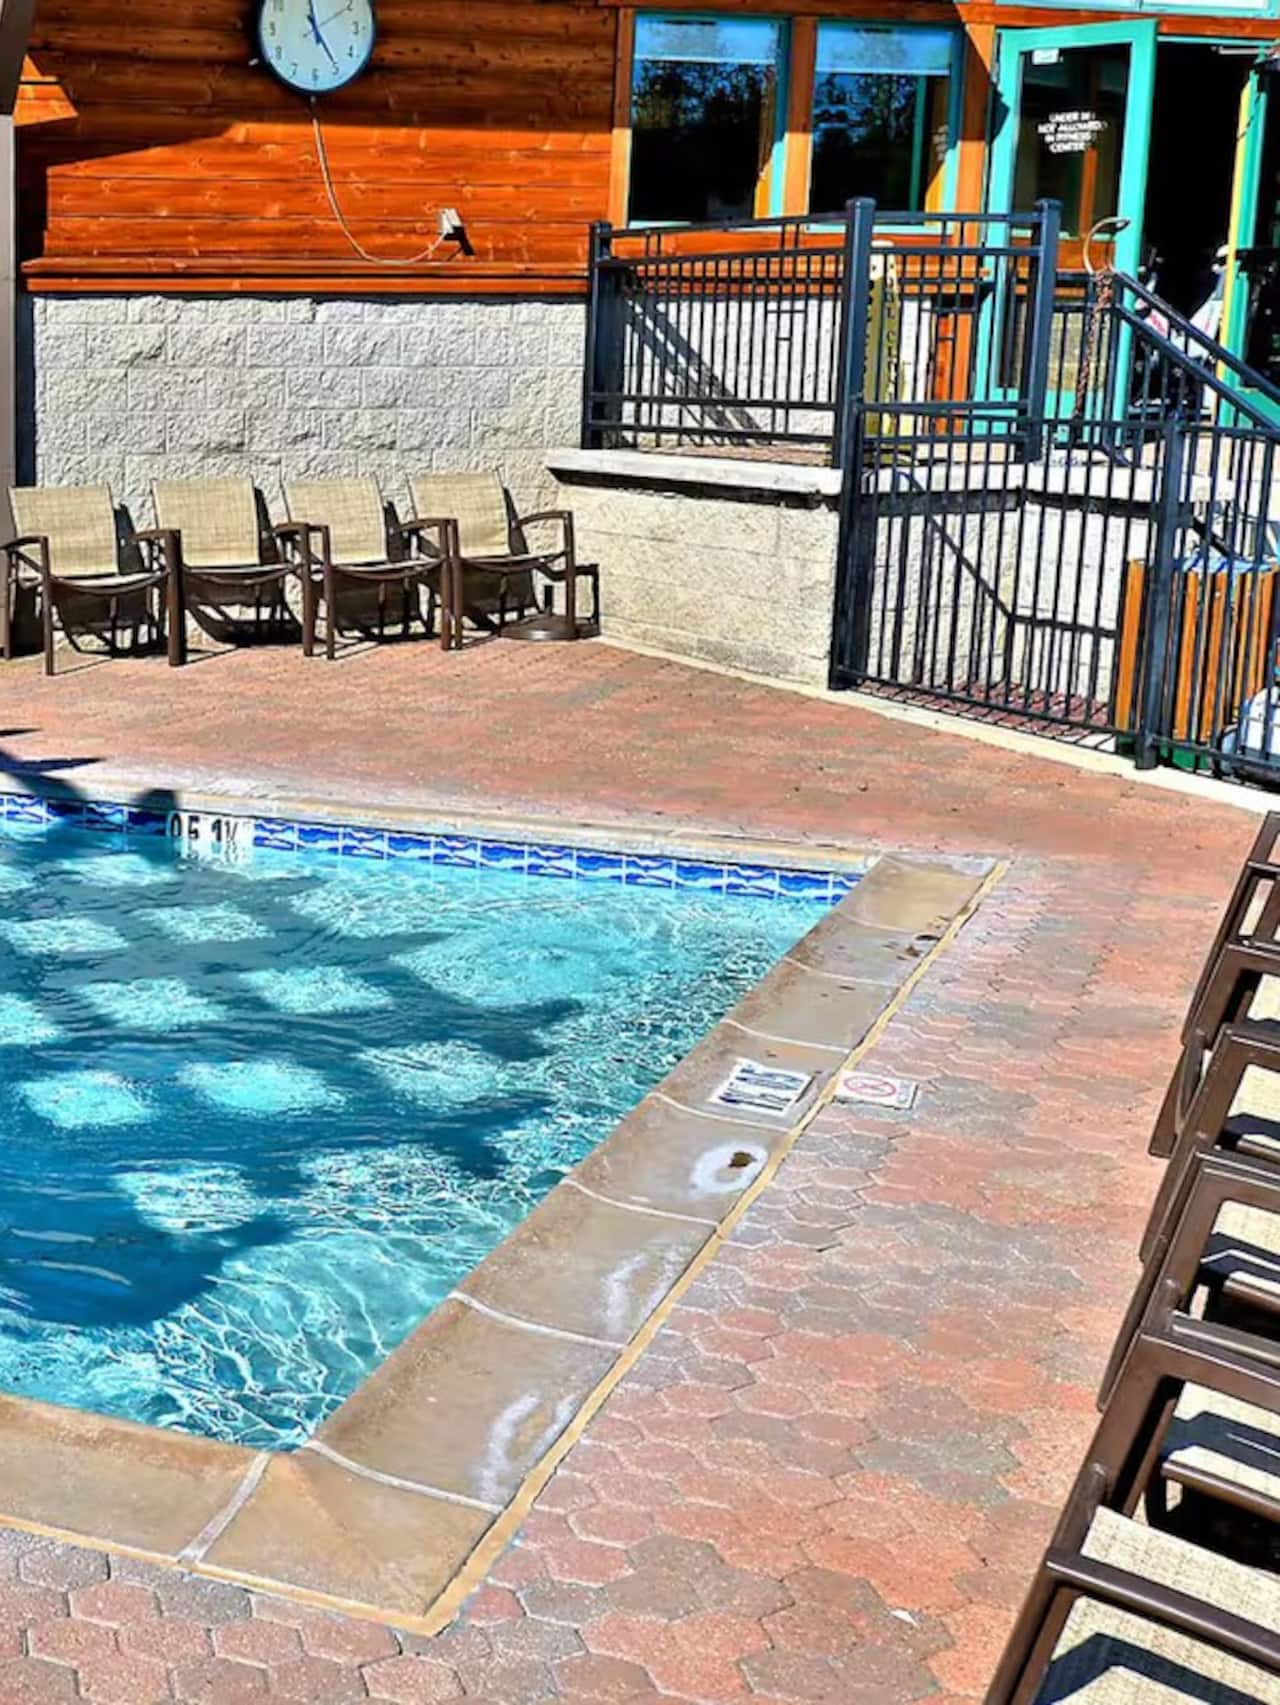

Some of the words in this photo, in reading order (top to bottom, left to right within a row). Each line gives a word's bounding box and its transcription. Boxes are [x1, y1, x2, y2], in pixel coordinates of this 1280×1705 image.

[1037, 123, 1056, 134] NOT
[1057, 120, 1102, 132] ALLOWED
[1048, 142, 1086, 154] CENTER
